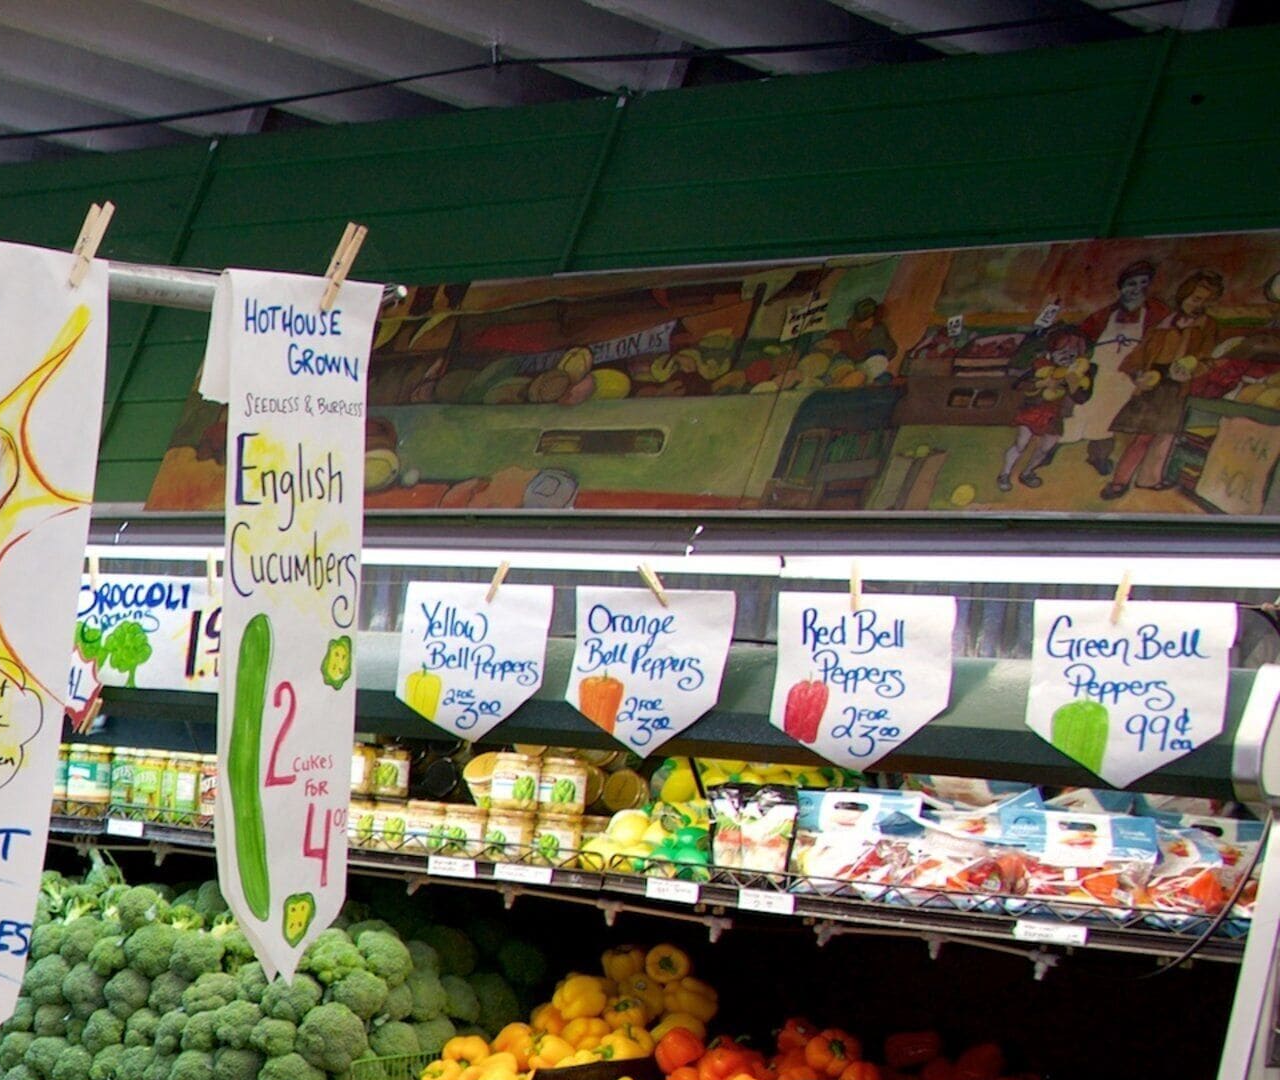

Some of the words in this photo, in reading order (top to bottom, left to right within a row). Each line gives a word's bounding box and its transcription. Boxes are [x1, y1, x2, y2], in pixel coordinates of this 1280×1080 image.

[244, 298, 342, 337] HOTHOUSE
[288, 343, 359, 382] GROWN
[235, 432, 344, 532] English
[230, 521, 358, 629] Cucumbers
[421, 600, 489, 642] Yellow
[588, 604, 676, 645] Orange
[802, 607, 846, 649] Red
[852, 608, 905, 657] Bell
[1046, 615, 1129, 666] Green
[1134, 625, 1210, 661] Bell
[426, 642, 471, 671] Bell
[465, 645, 538, 687] Peppers
[577, 638, 628, 674] Bell
[630, 646, 704, 691] Peppers
[812, 650, 906, 699] Peppers
[1064, 663, 1175, 711] Peppers
[264, 680, 297, 787] 2
